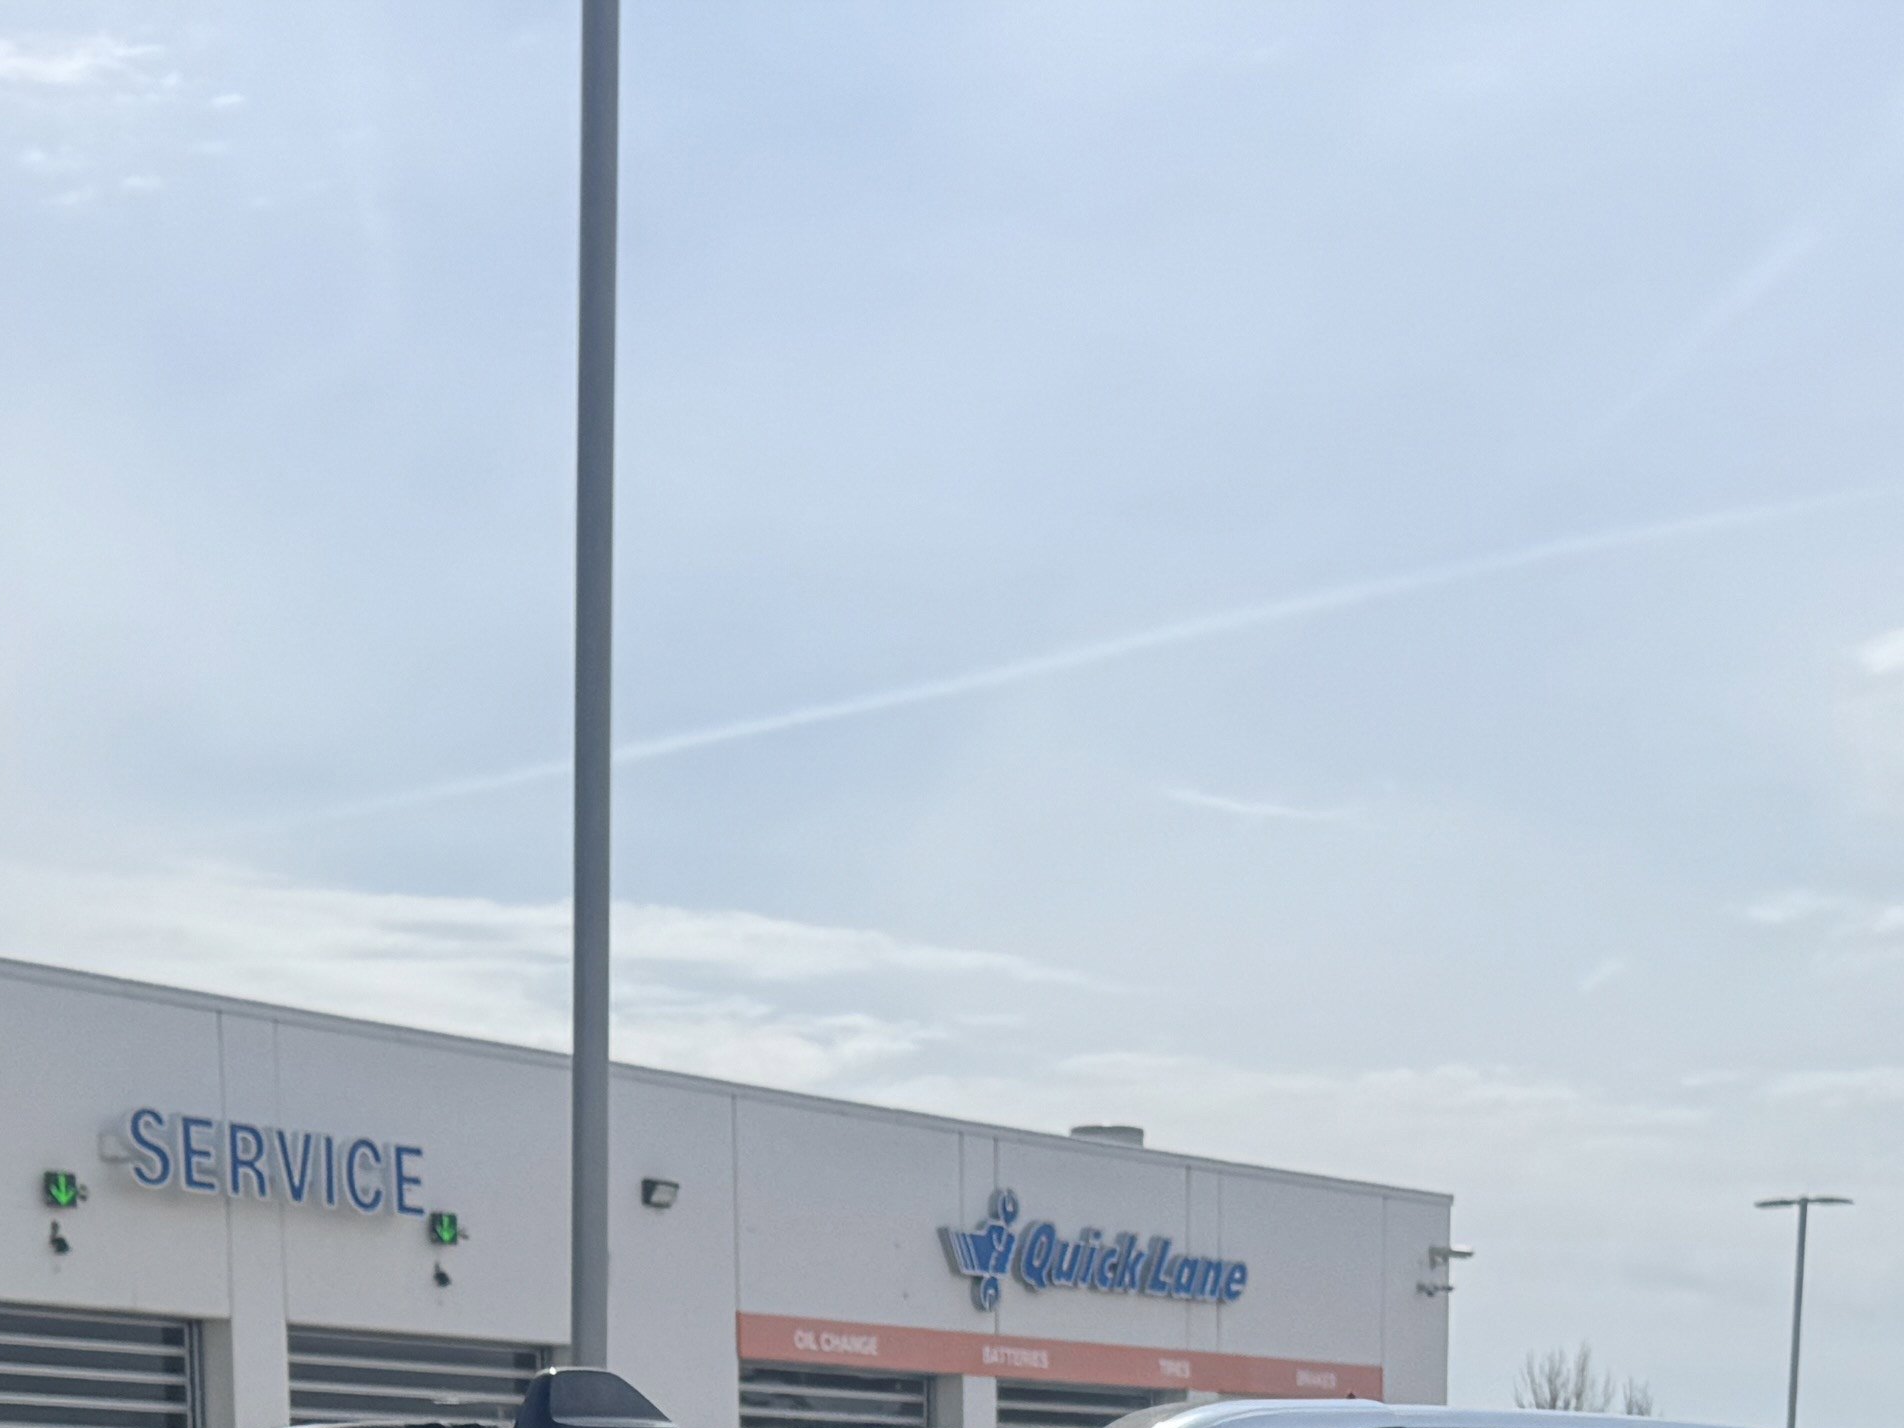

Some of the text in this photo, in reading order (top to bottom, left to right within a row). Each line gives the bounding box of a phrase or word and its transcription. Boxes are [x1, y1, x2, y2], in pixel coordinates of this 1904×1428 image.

[128, 1106, 427, 1218] SERVICE
[1021, 1223, 1249, 1302] Quick Lane
[794, 1329, 878, 1356] OIL CHANGE
